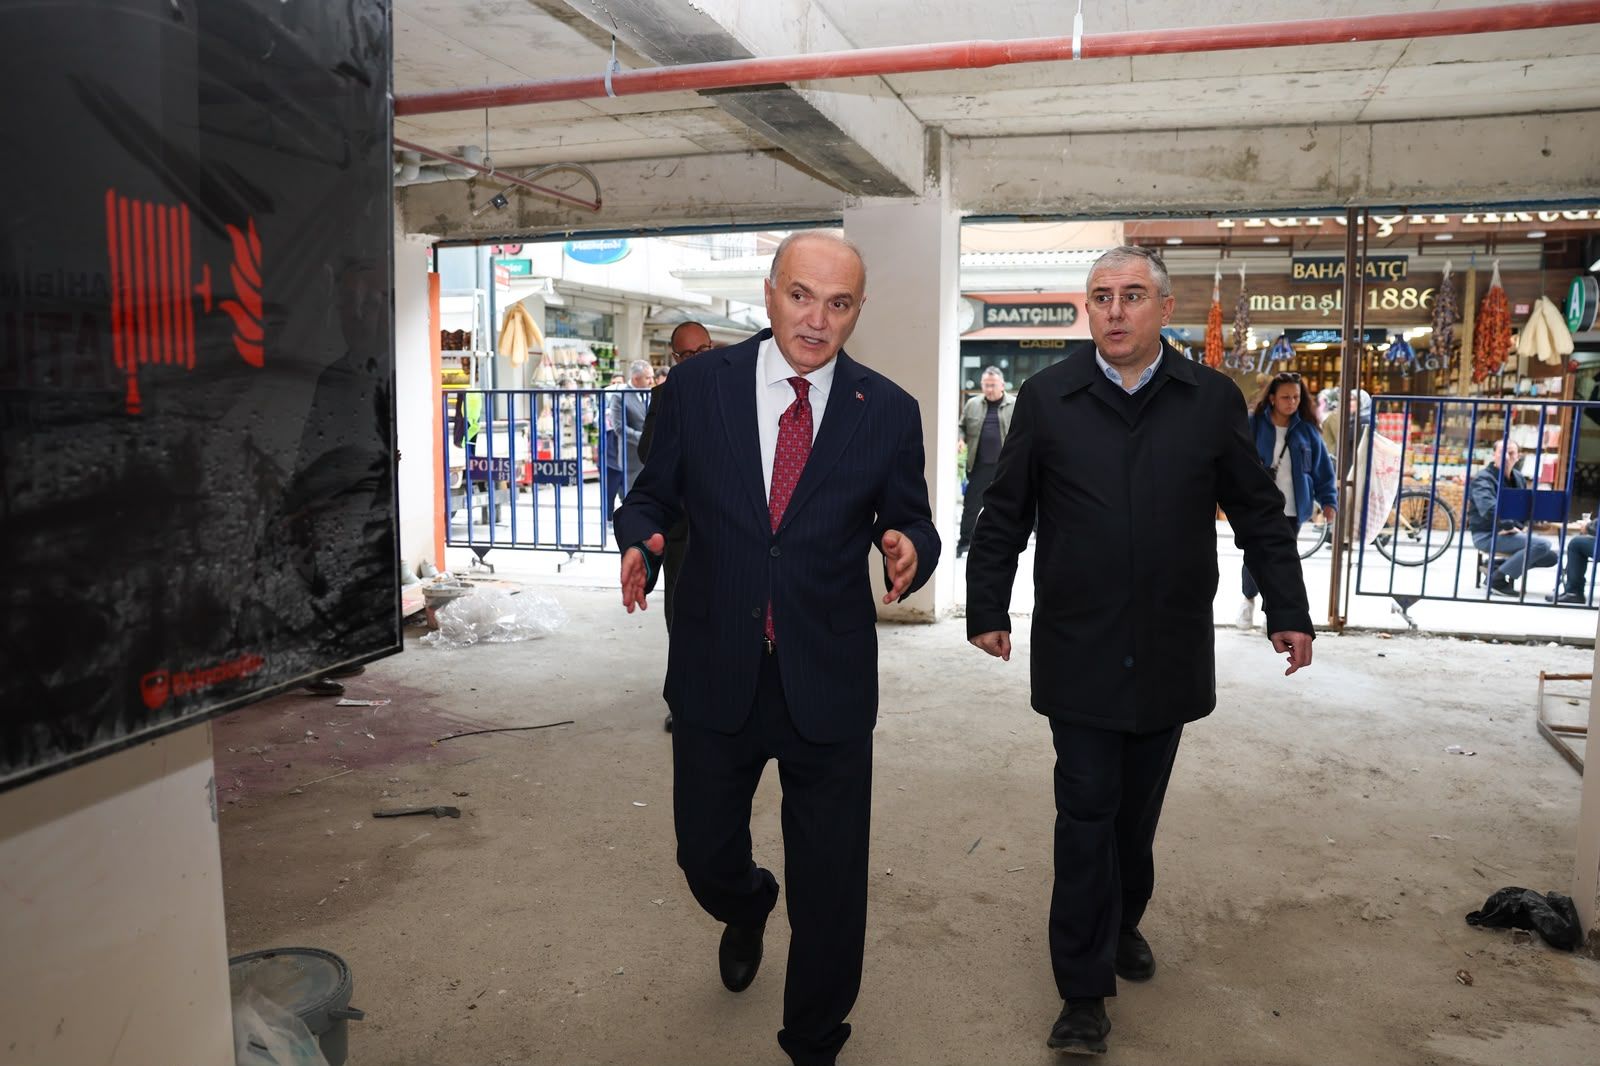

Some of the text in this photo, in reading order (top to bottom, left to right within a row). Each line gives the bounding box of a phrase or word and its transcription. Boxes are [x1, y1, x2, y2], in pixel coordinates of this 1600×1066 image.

[1569, 281, 1580, 319] A
[987, 307, 1074, 325] SAATÇILIK
[1019, 340, 1065, 348] CASIO
